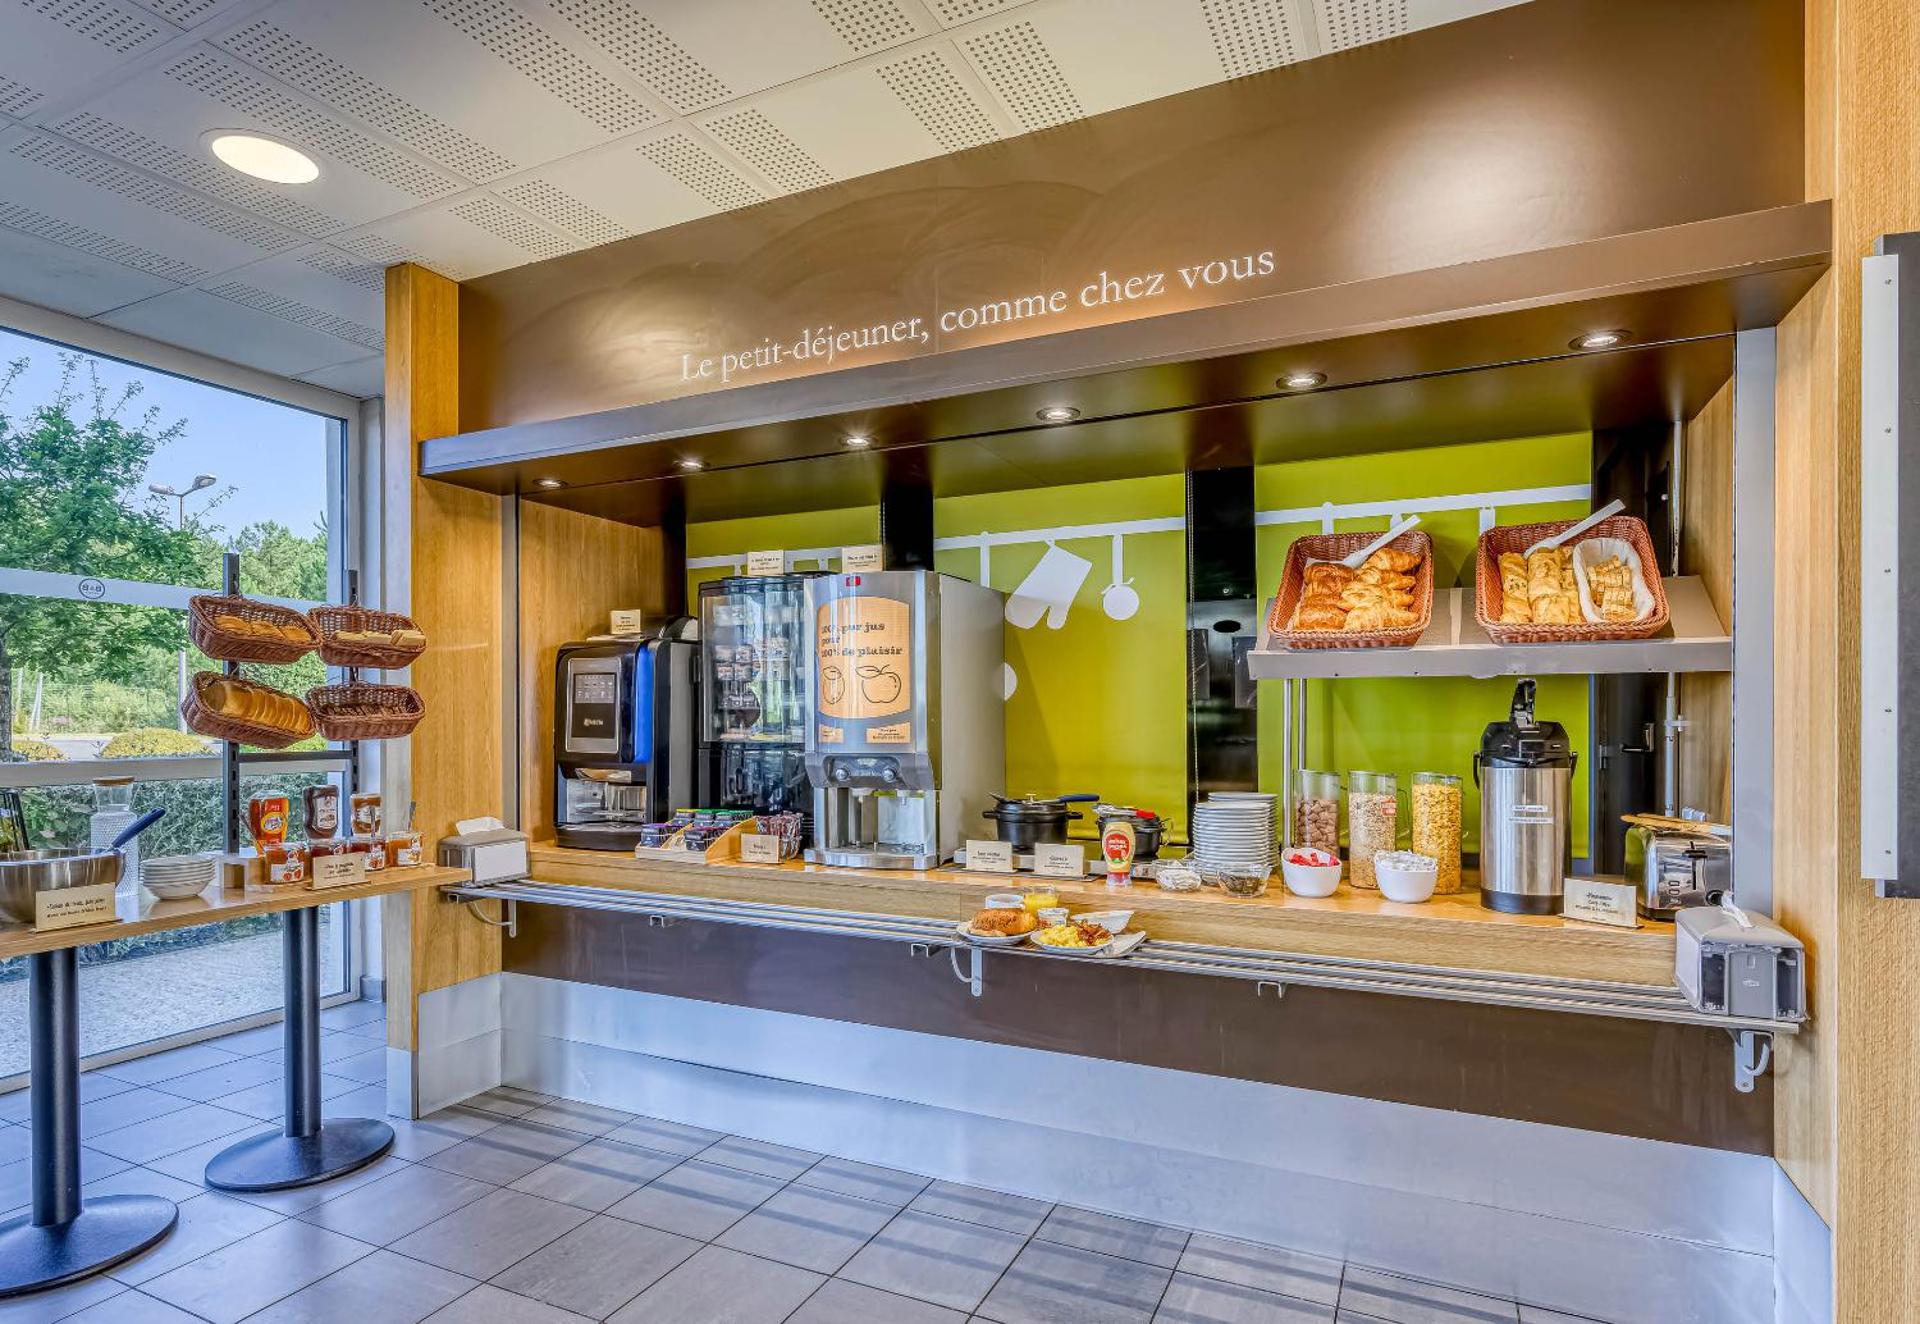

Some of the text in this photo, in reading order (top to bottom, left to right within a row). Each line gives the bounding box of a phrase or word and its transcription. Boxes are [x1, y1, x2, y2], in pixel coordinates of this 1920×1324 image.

[680, 249, 1276, 383] Le petit-déjeuner, comme chez vous
[864, 622, 885, 633] jus
[857, 645, 903, 657] plaisir
